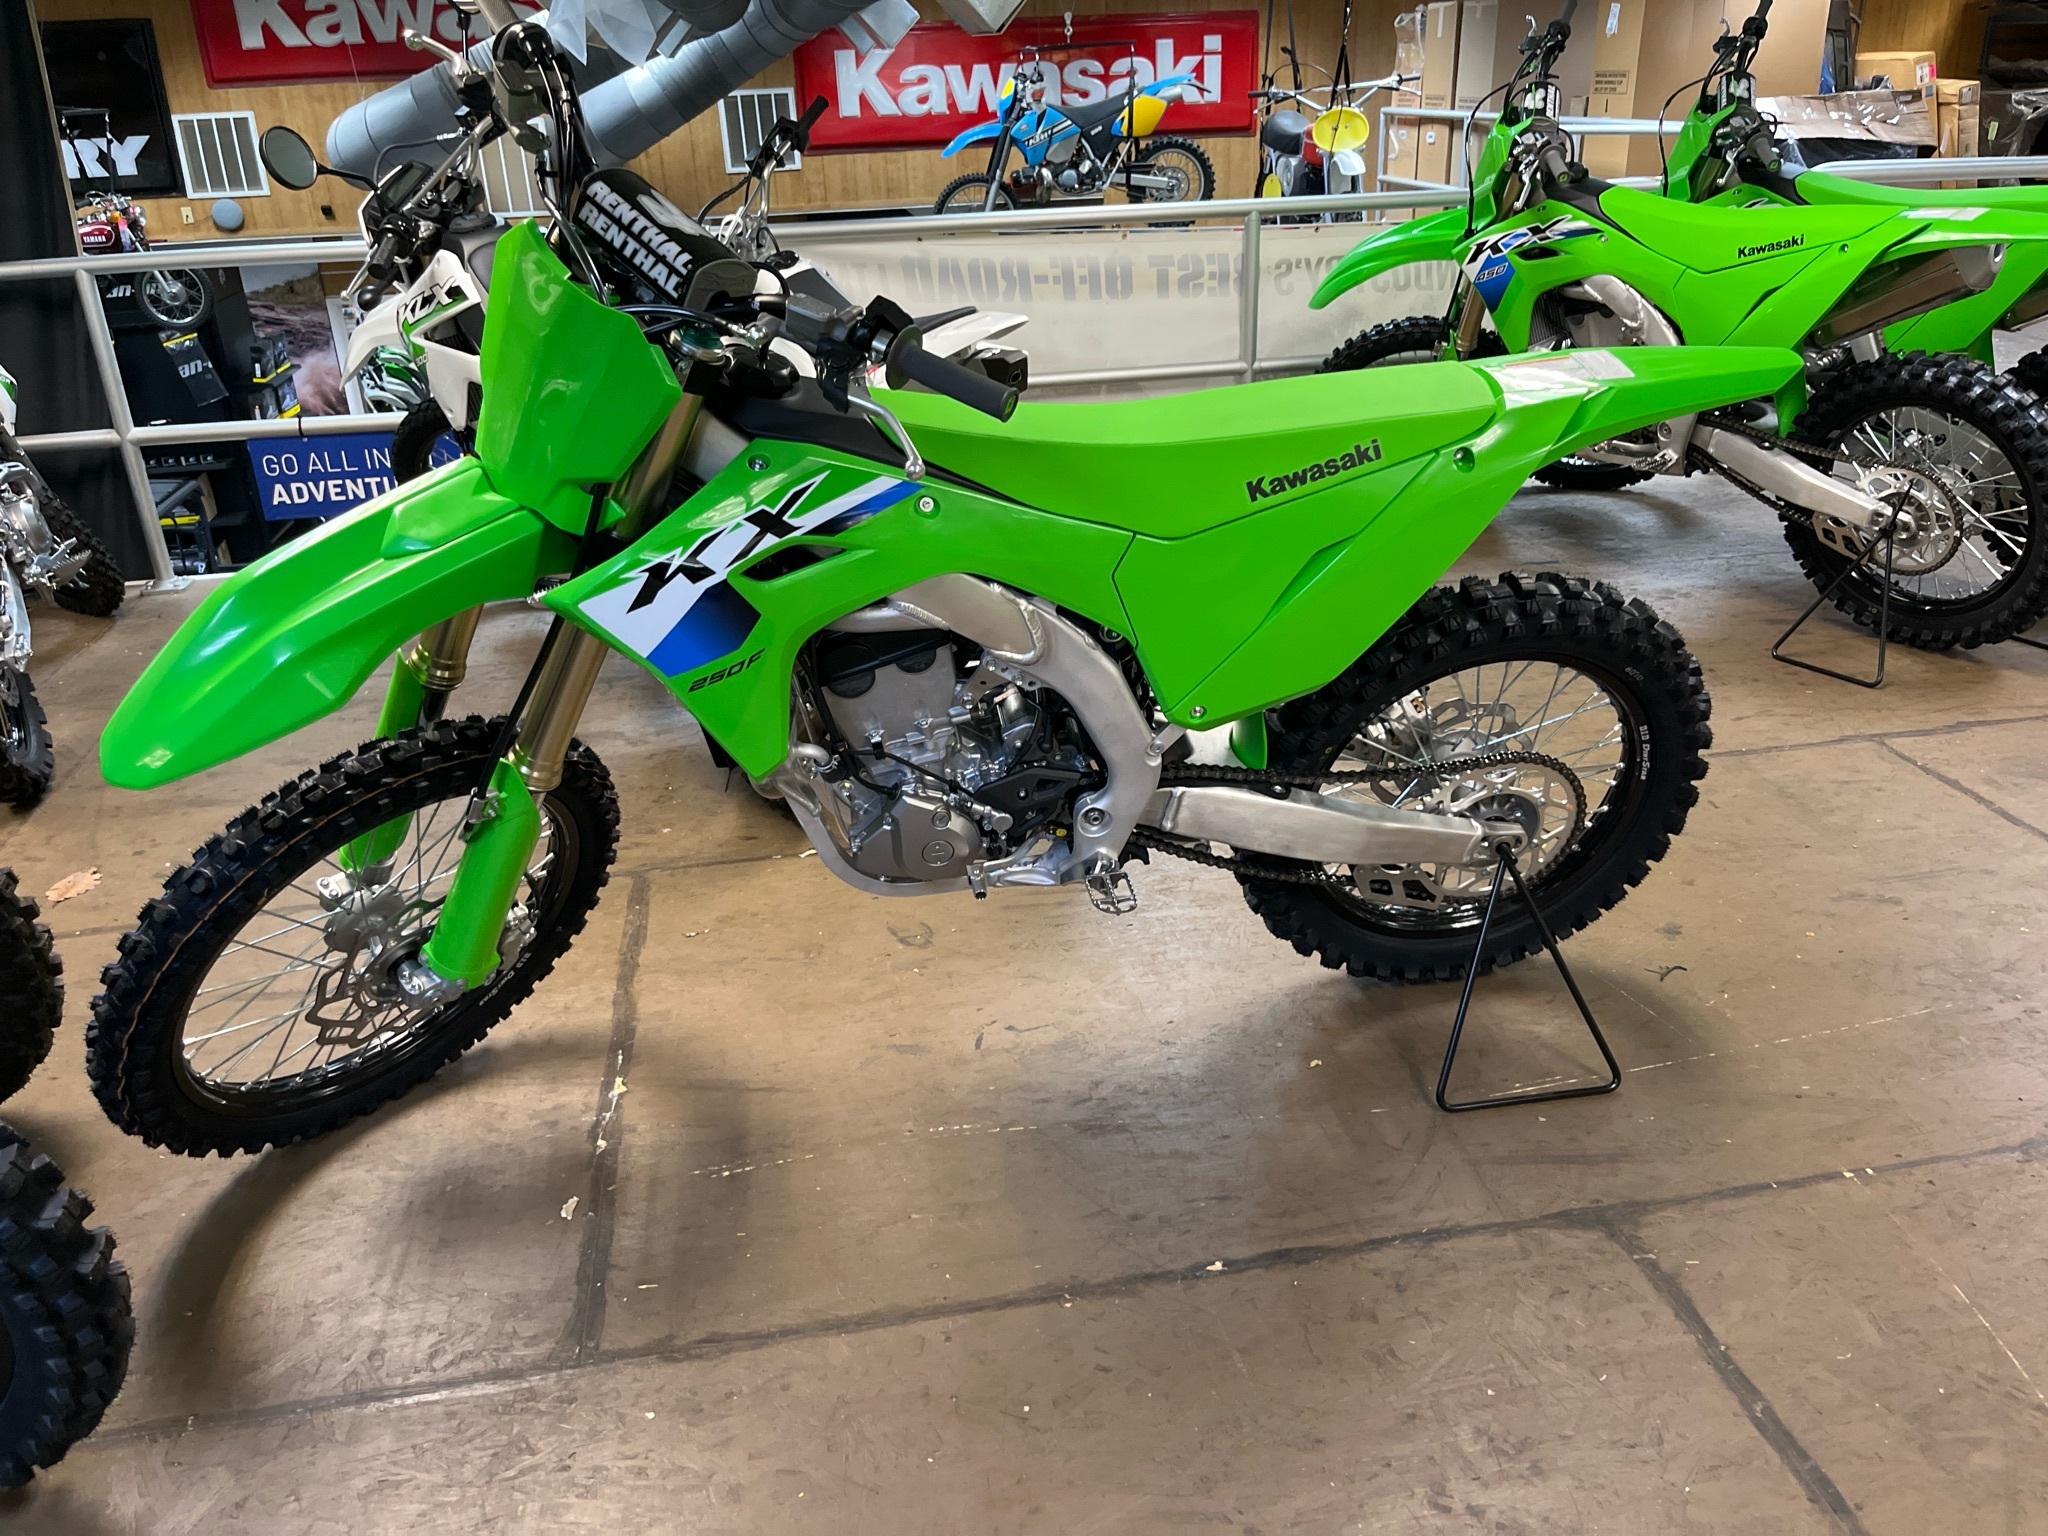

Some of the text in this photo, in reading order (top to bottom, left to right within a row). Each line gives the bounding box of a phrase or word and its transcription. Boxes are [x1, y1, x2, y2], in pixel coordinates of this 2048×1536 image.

[834, 35, 1222, 118] Kawasaki
[83, 235, 107, 243] YAMAHA
[578, 201, 679, 299] RENTHAL
[586, 180, 693, 276] RENTHAL
[1466, 215, 1570, 267] KX
[1738, 233, 1805, 259] Kawasaki
[1475, 262, 1508, 283] 450
[397, 276, 457, 327] KLX
[262, 447, 390, 477] GO ALL IN
[1246, 438, 1382, 502] Kawasaki
[625, 469, 832, 615] KX
[688, 647, 766, 694] 250F
